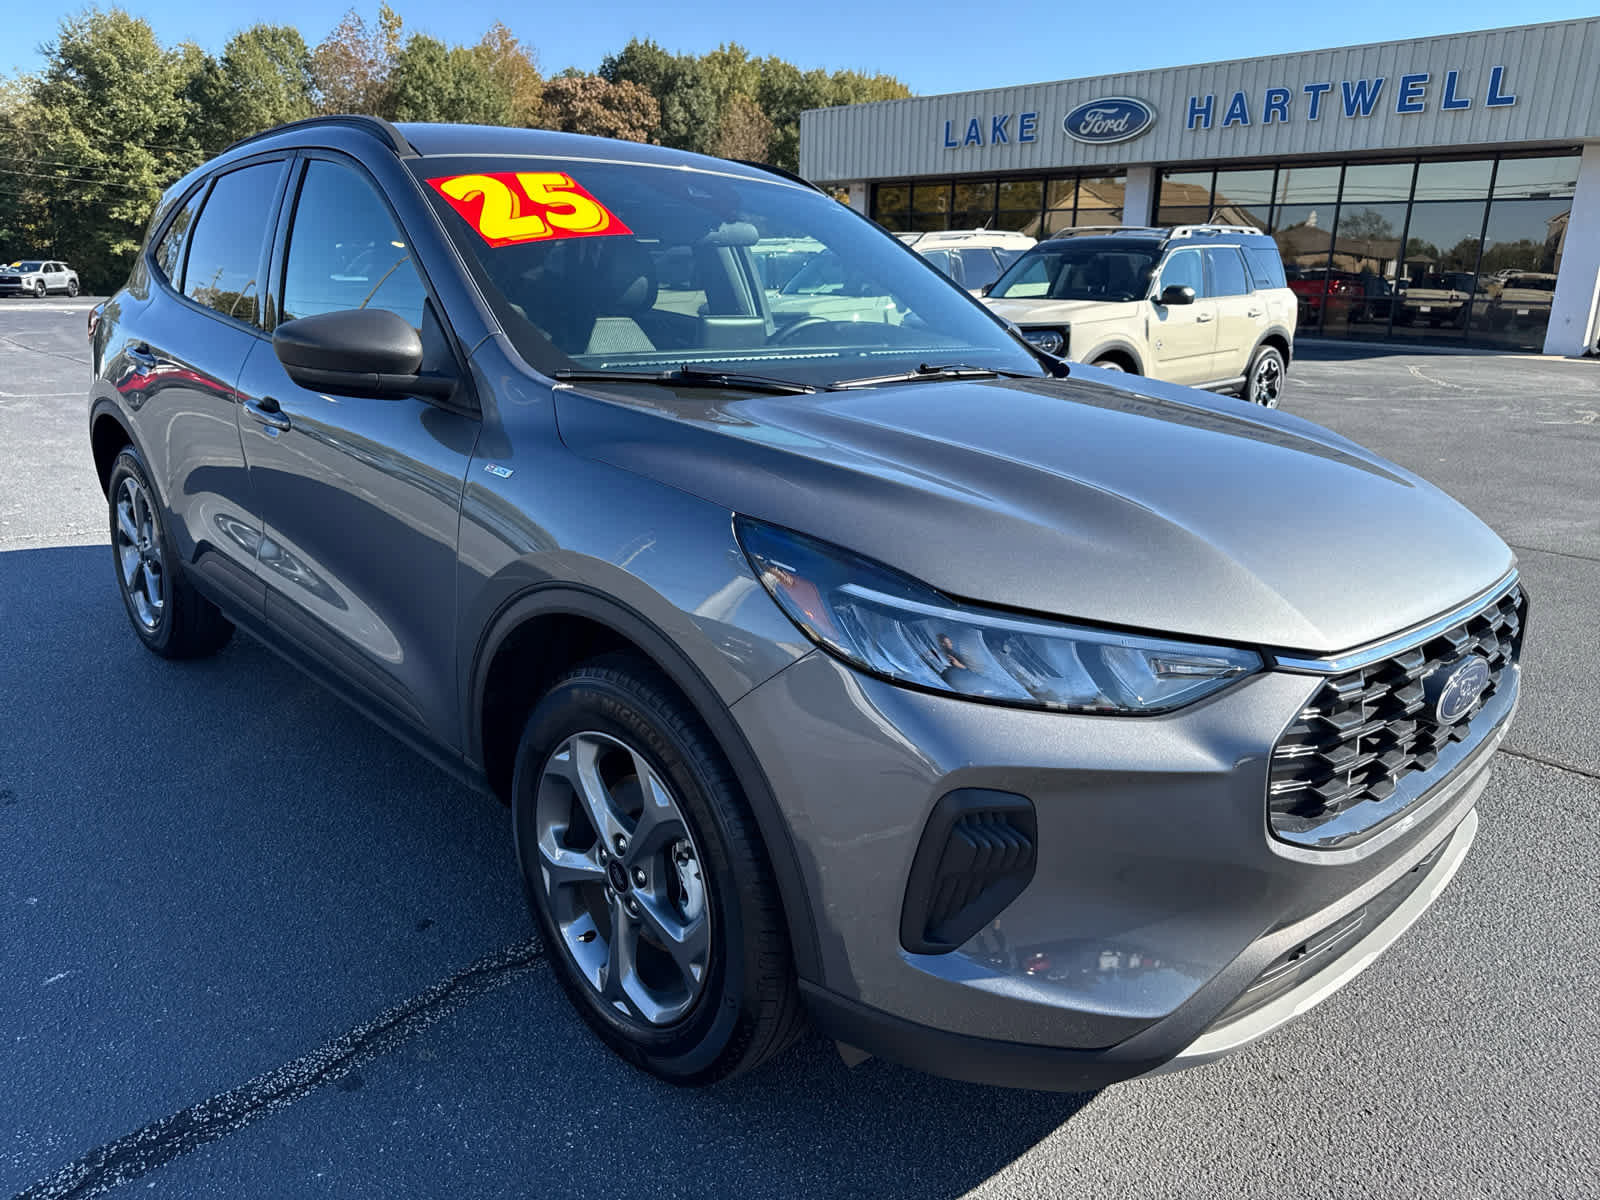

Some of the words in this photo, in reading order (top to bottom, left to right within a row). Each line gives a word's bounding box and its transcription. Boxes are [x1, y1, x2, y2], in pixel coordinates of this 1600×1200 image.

[943, 112, 1037, 148] LAKE
[1079, 107, 1131, 135] Ford
[1186, 65, 1517, 130] HARTWELL
[440, 172, 610, 241] 25
